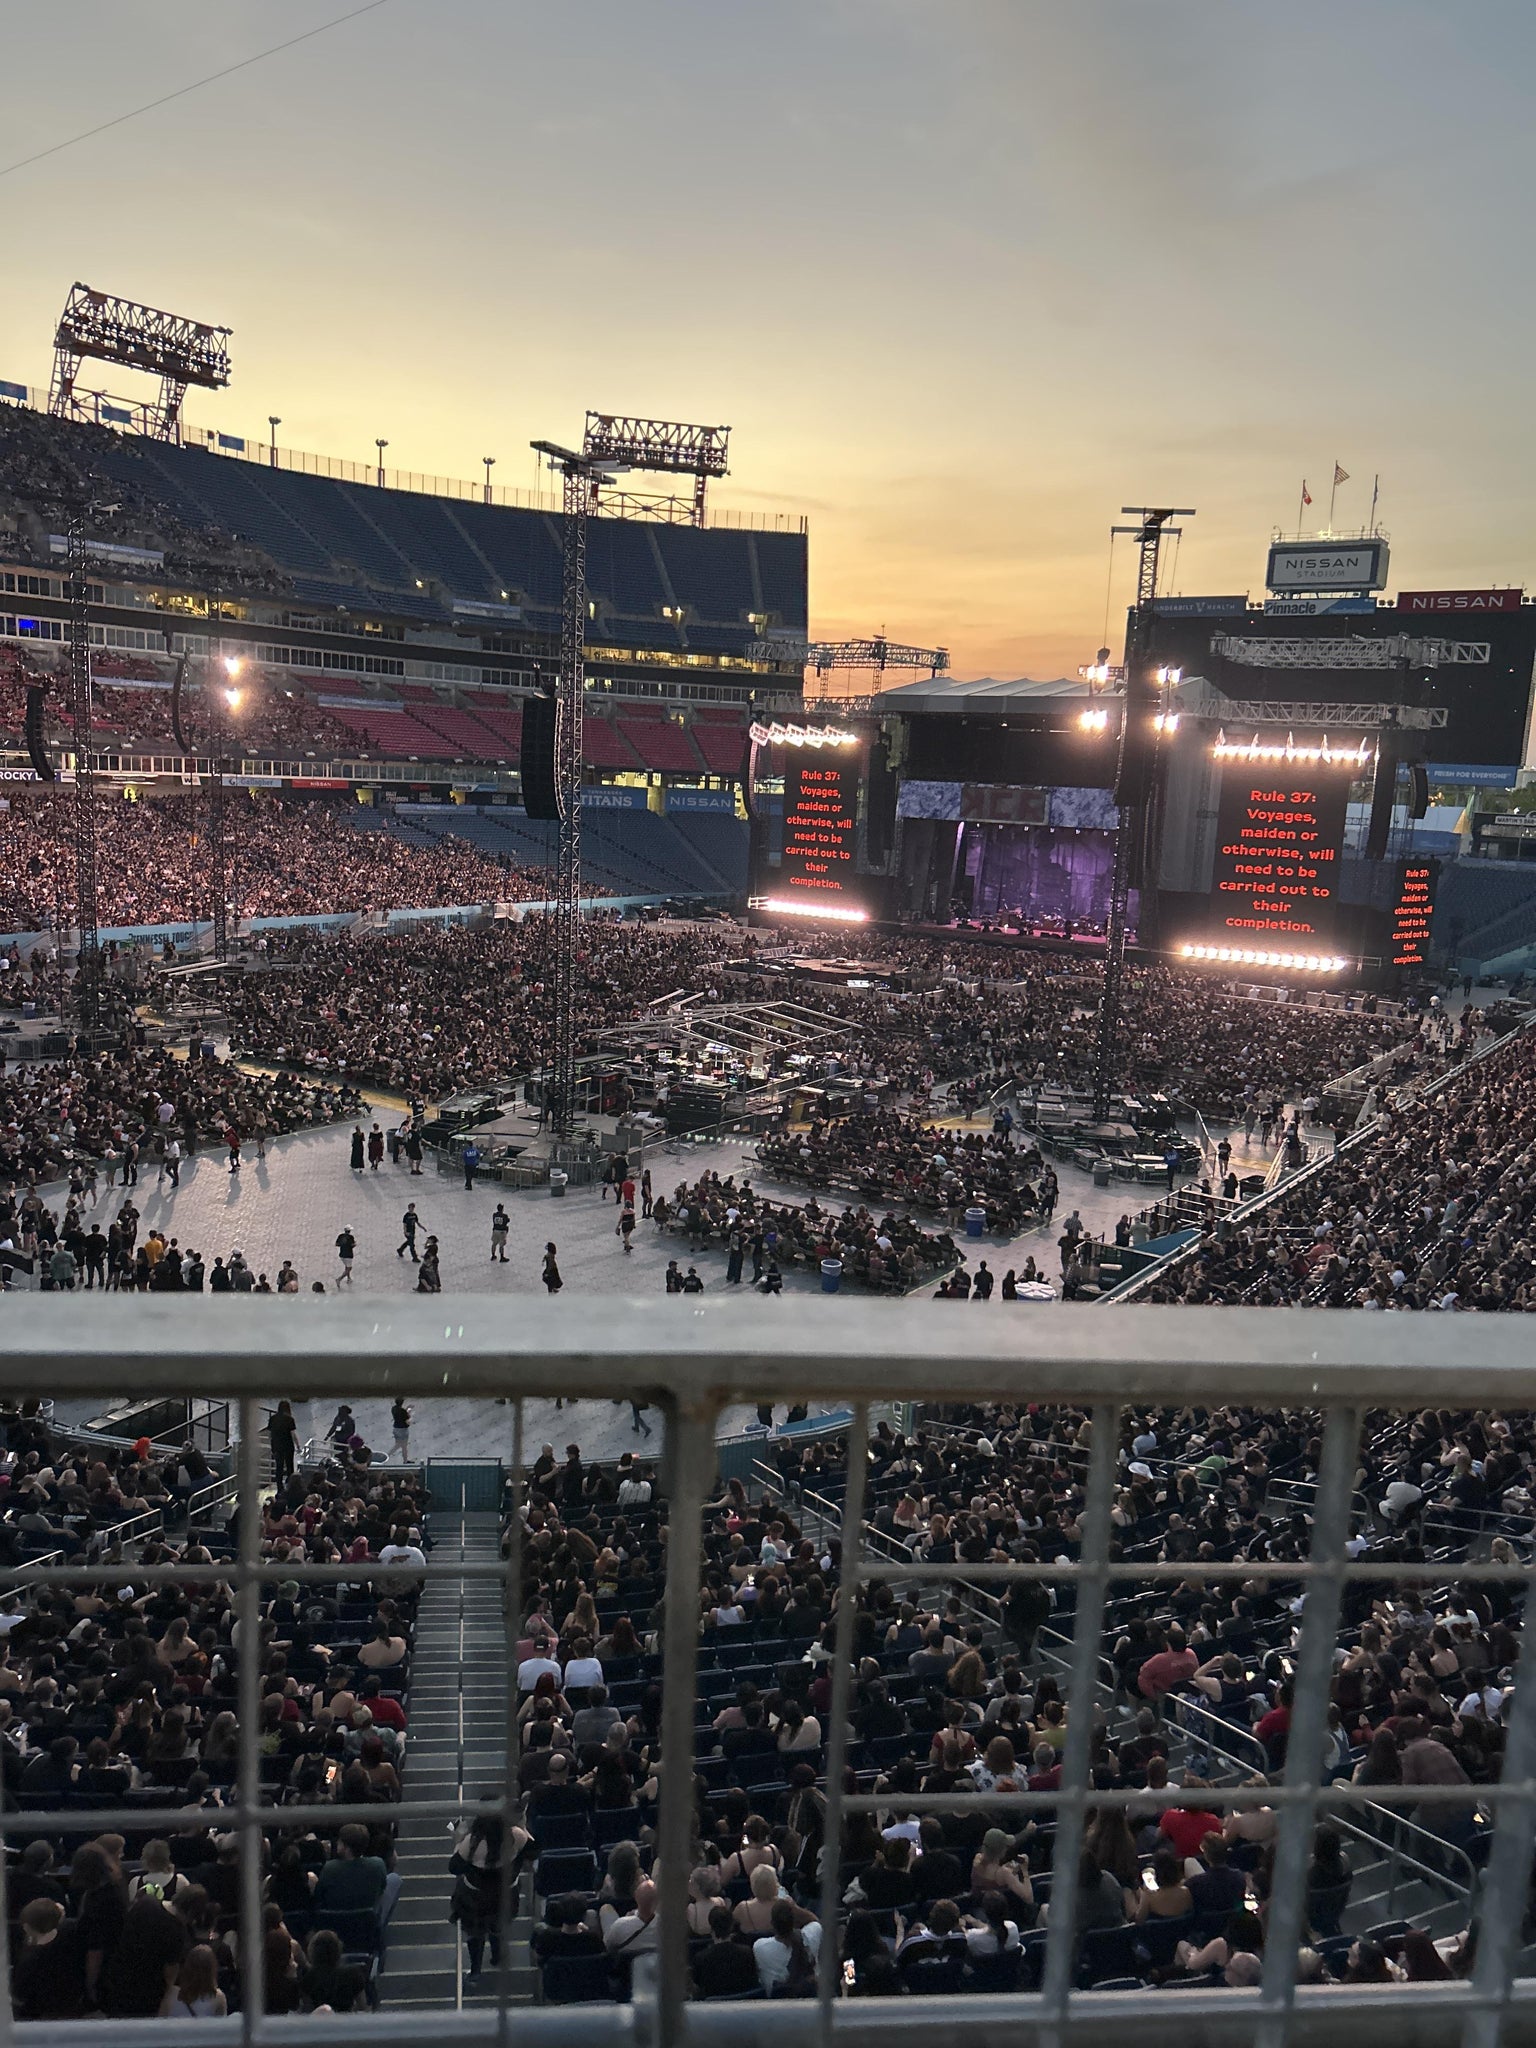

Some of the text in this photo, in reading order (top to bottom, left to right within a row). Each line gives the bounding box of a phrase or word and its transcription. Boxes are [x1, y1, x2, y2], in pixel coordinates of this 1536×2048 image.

[1286, 557, 1359, 569] NISSAN
[1297, 570, 1345, 578] STADIUM
[1265, 601, 1316, 614] Pinnacle
[1412, 596, 1504, 609] NISSAN
[801, 769, 840, 781] Rule 37:
[800, 786, 840, 799] Voyages,
[1250, 790, 1316, 804] Rule 37:
[580, 794, 633, 807] TITANS
[670, 797, 731, 808] NISSAN
[796, 801, 842, 813] maiden or
[786, 815, 852, 829] otherwise, will
[1248, 809, 1316, 825] Voyages,
[794, 831, 843, 844] need to be
[1241, 828, 1317, 841] maiden or
[785, 846, 851, 860] carried out to
[1222, 844, 1334, 861] otherwise, will
[804, 862, 828, 873] their
[1235, 865, 1316, 878] need to be
[1406, 869, 1429, 878] Rule 37:
[789, 877, 842, 890] completion.
[1219, 882, 1329, 898] carried out to
[1405, 882, 1428, 892] Voyages,
[1402, 894, 1421, 903] maiden
[1253, 900, 1290, 913] their
[1395, 905, 1432, 915] otherwise, will
[1226, 918, 1315, 933] completion.
[1399, 919, 1412, 928] need
[1412, 919, 1419, 927] to
[1392, 930, 1428, 940] carried out to
[1404, 943, 1416, 951] their
[1394, 955, 1423, 964] completion.
